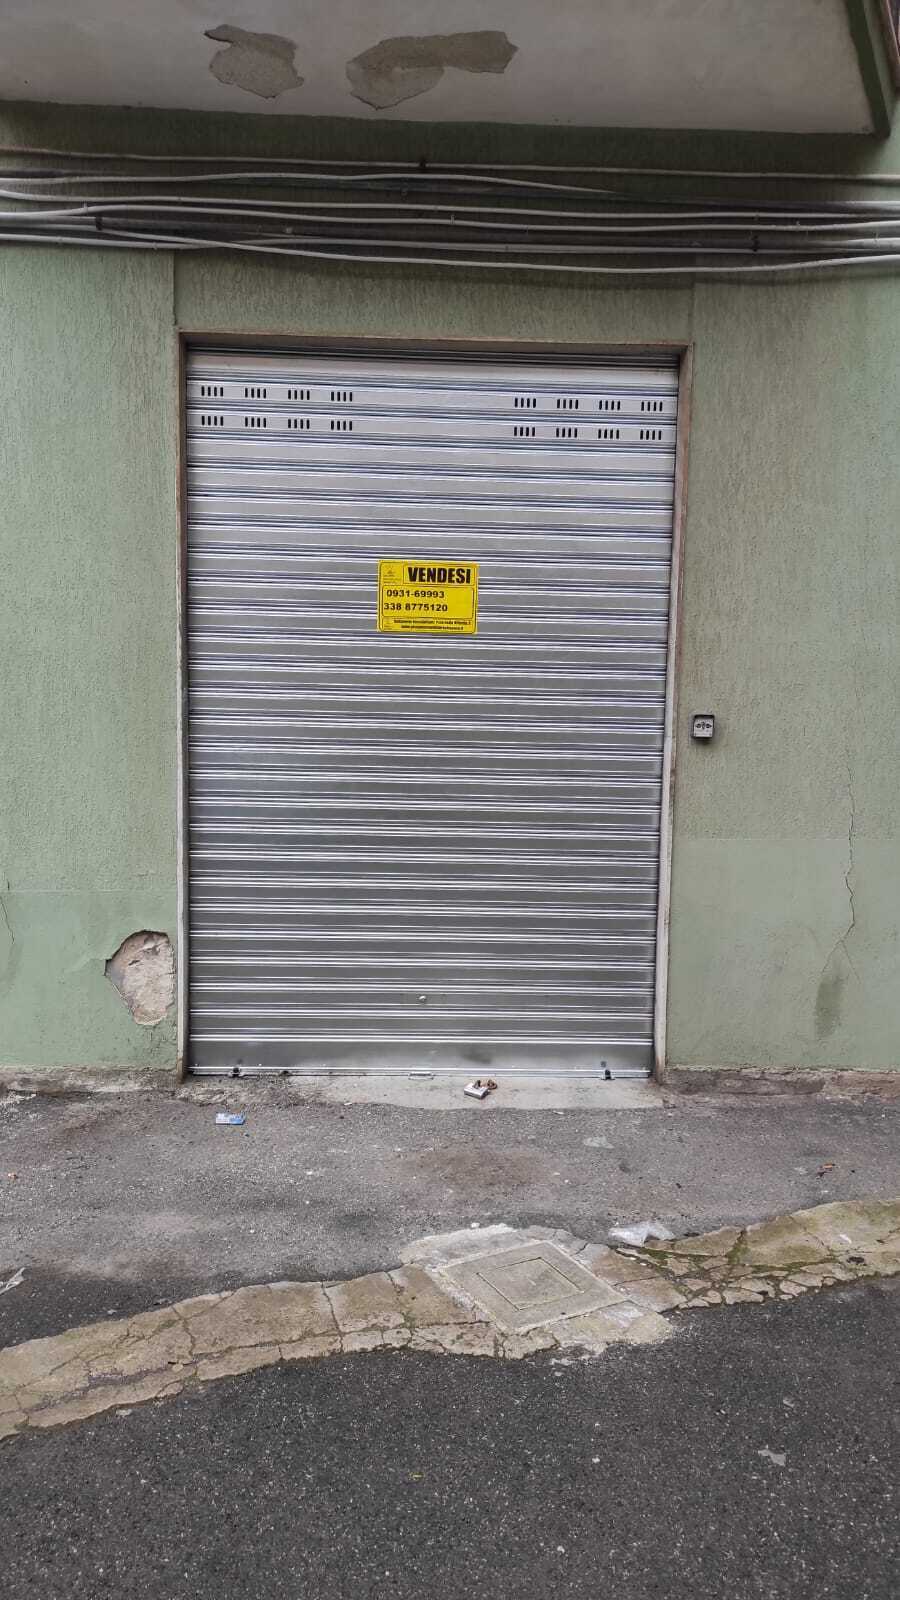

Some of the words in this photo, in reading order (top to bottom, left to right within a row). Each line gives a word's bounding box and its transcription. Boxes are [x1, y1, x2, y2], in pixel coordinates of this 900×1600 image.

[408, 567, 471, 584] VENDESI
[386, 589, 445, 598] 0931-69993
[384, 603, 402, 611] 338
[405, 603, 448, 612] 8775120
